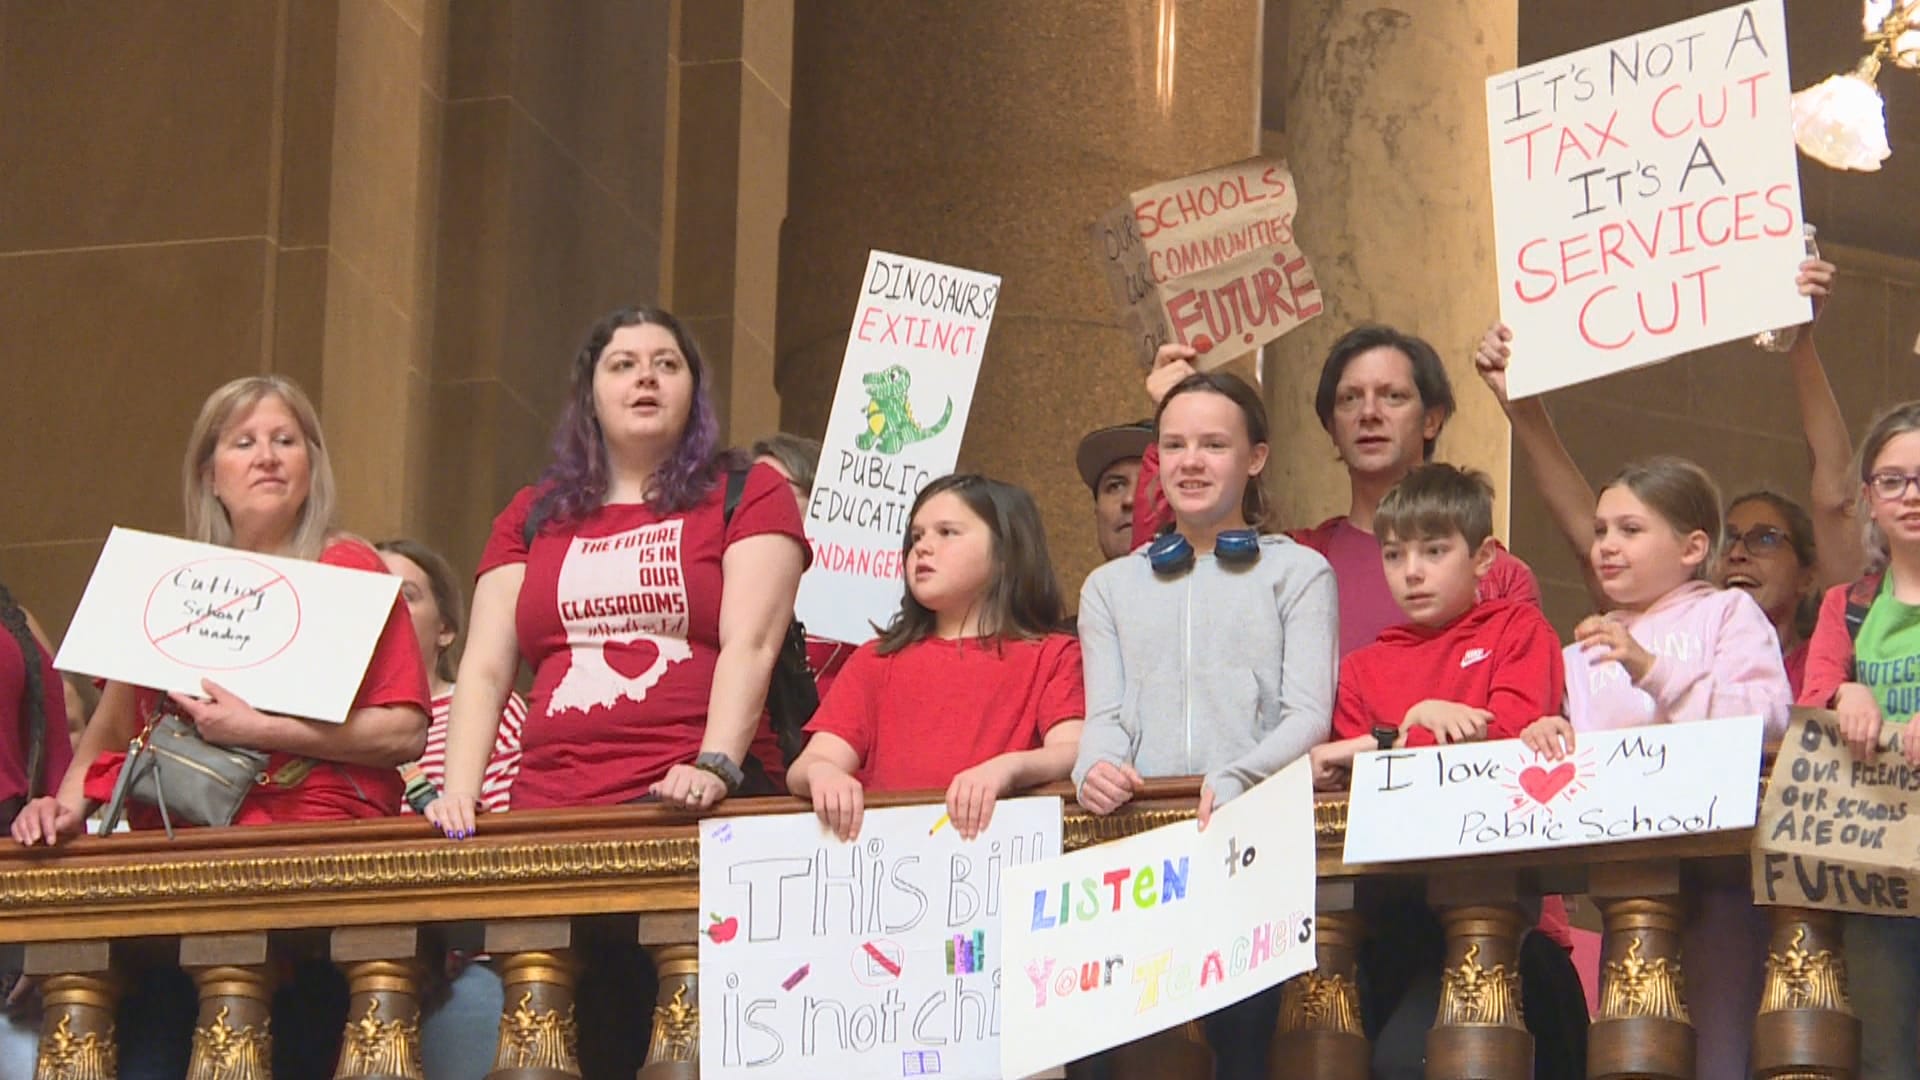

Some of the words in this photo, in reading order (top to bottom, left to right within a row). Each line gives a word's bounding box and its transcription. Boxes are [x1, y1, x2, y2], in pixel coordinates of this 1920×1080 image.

[1497, 63, 1596, 124] IT'S
[1609, 31, 1706, 96] NOT
[1725, 8, 1769, 70] A
[1503, 109, 1629, 181] TAX
[1651, 72, 1771, 139] CUT
[1135, 167, 1286, 239] SCHOOLS
[1567, 159, 1662, 219] IT'S
[1679, 137, 1726, 193] A
[1150, 211, 1294, 284] COMMUNITIES
[1514, 184, 1794, 304] SERVICES
[1166, 255, 1322, 347] FUTURE
[1578, 264, 1722, 350] CUT
[838, 449, 930, 497] PUBLIC
[810, 487, 909, 534] EDUCATI
[580, 539, 612, 555] THE
[614, 526, 679, 551] FUTURE
[638, 547, 655, 564] IS
[659, 545, 677, 563] IN
[639, 567, 680, 587] OUR
[561, 592, 686, 622] CLASSROOMS
[1375, 754, 1417, 791] I
[1437, 751, 1500, 787] love
[1606, 735, 1668, 777] My
[1791, 757, 1840, 783] OUR
[1851, 760, 1920, 792] FRIENDS
[1771, 811, 1834, 846] ARE
[1840, 824, 1887, 849] OUR
[1782, 785, 1828, 812] OUR
[1833, 797, 1908, 821] SCHOOLS
[1224, 836, 1257, 878] to
[1765, 852, 1909, 909] FUTURE
[801, 989, 906, 1057] not
